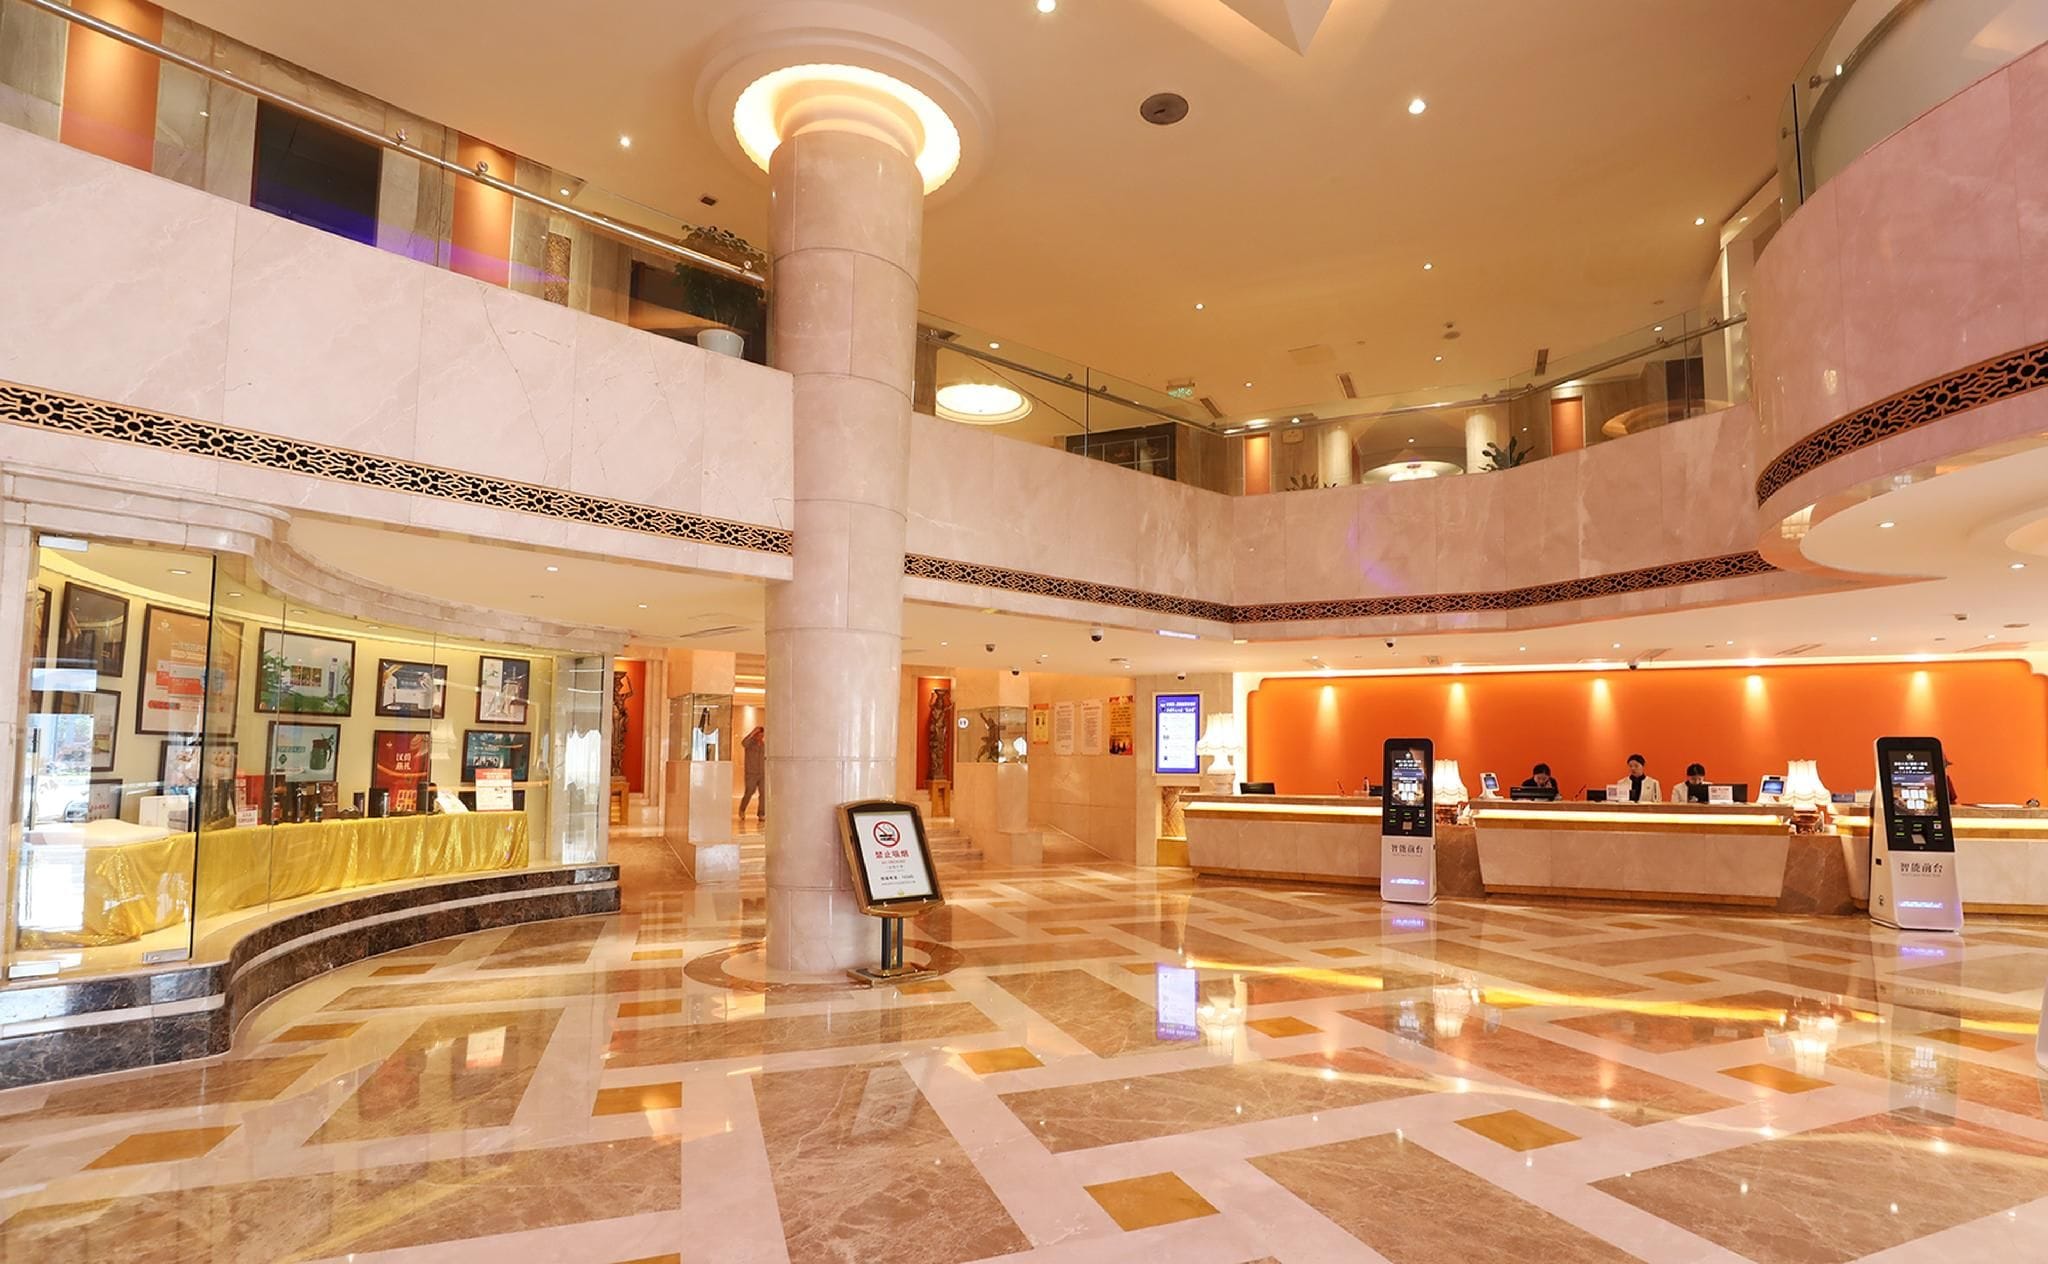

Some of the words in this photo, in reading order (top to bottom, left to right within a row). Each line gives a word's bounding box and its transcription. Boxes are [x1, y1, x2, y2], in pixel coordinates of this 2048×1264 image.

[875, 849, 910, 860] 禁止吸烟
[1391, 844, 1424, 854] 智能前台
[1900, 862, 1943, 873] 智能前台
